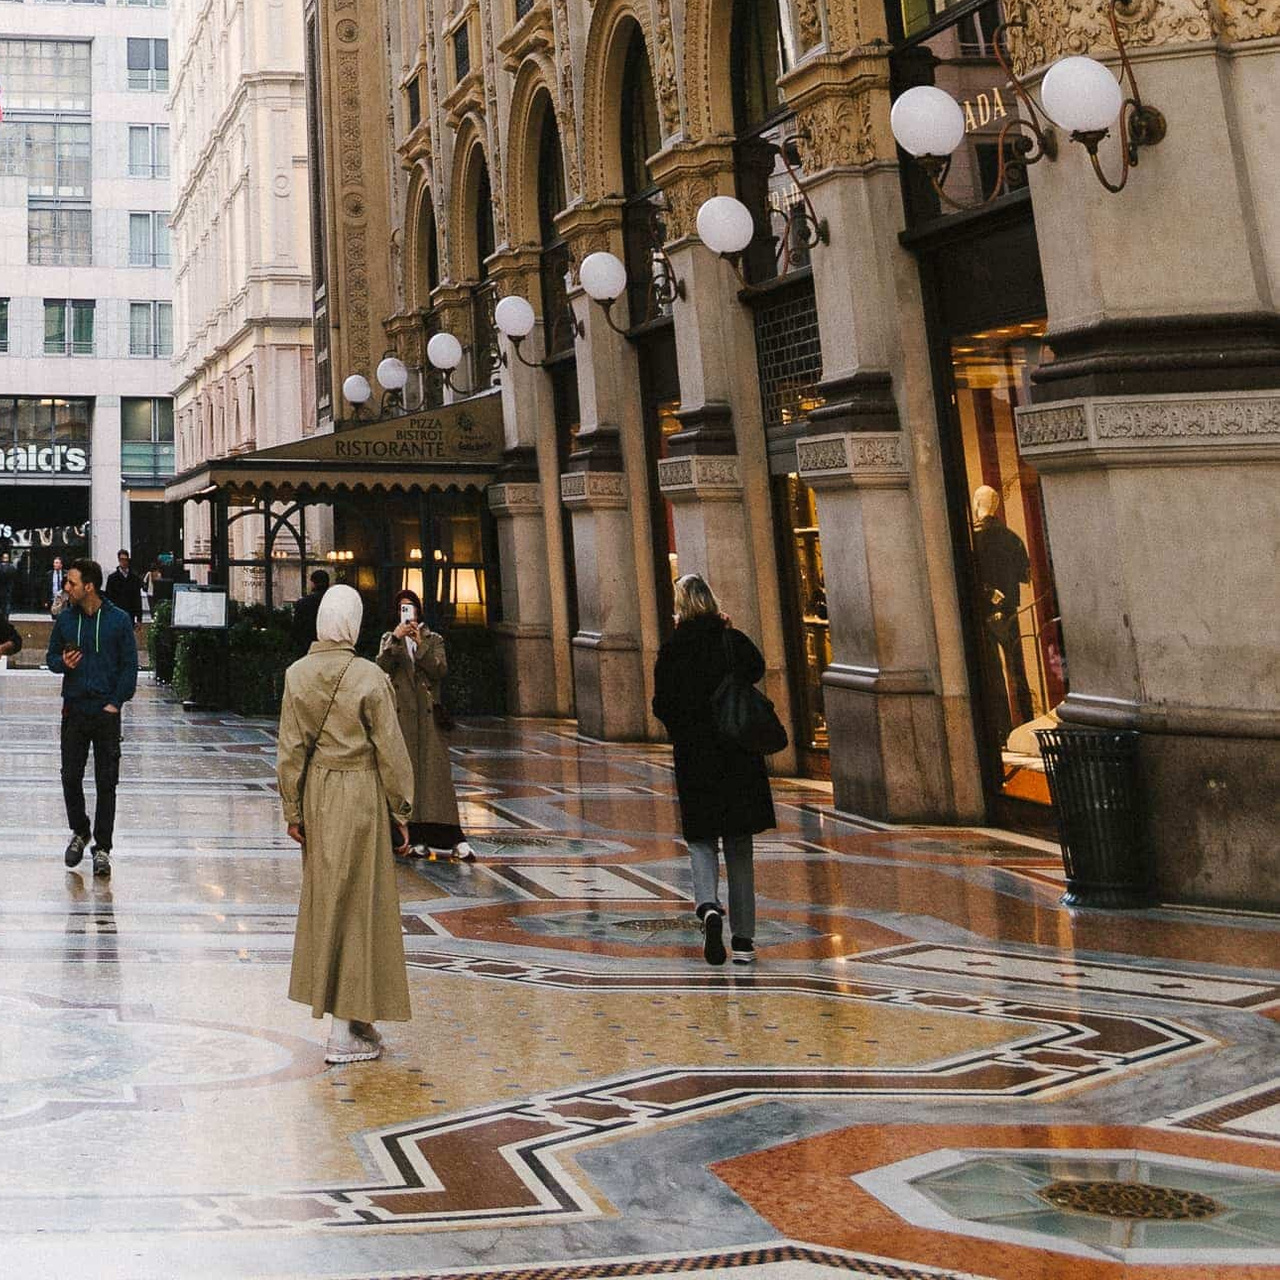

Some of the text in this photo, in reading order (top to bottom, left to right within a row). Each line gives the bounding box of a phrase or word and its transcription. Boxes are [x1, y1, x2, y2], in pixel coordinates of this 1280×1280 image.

[964, 87, 1008, 133] ADA
[410, 418, 442, 429] PIZZA
[395, 430, 443, 440] BISTROT
[335, 441, 445, 457] RISTORANTE
